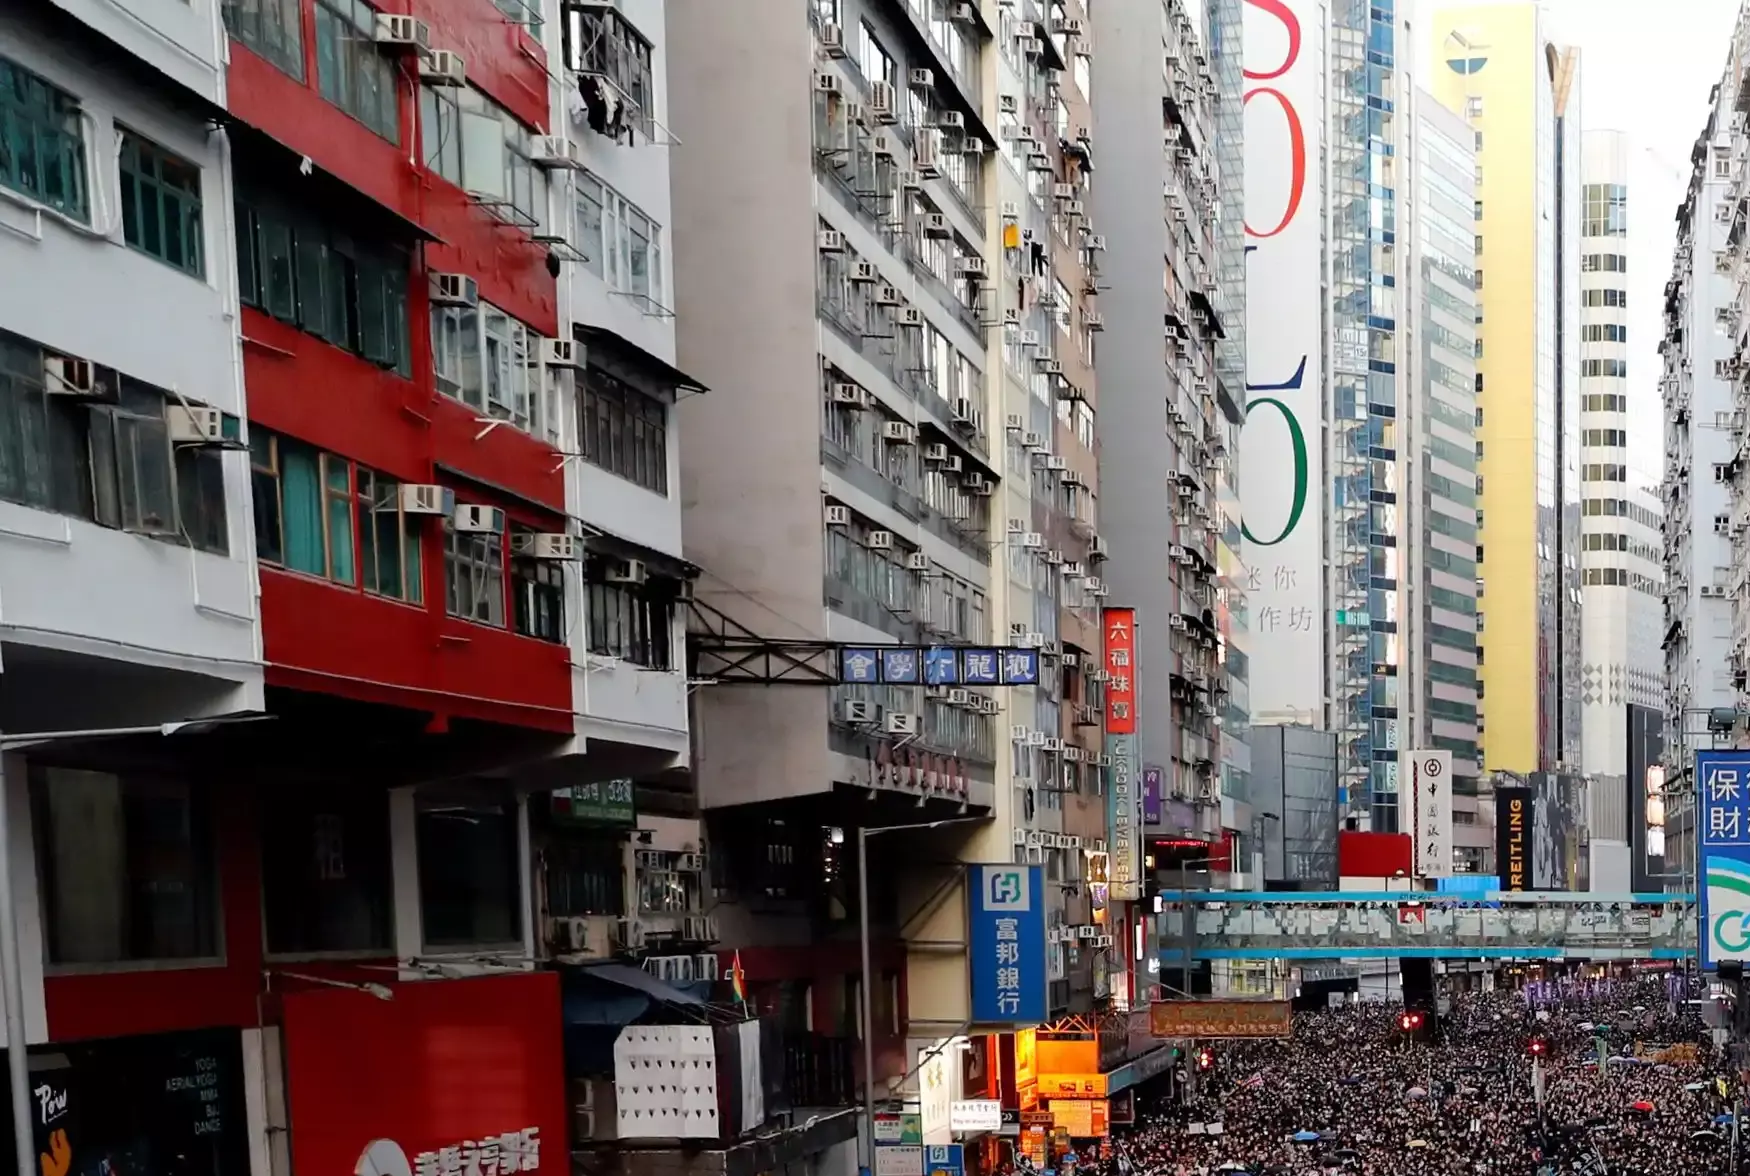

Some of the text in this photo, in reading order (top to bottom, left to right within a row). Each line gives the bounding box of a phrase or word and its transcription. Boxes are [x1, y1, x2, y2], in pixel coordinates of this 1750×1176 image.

[1510, 799, 1523, 892] BREITLING
[995, 917, 1020, 1014] 富邦銀行
